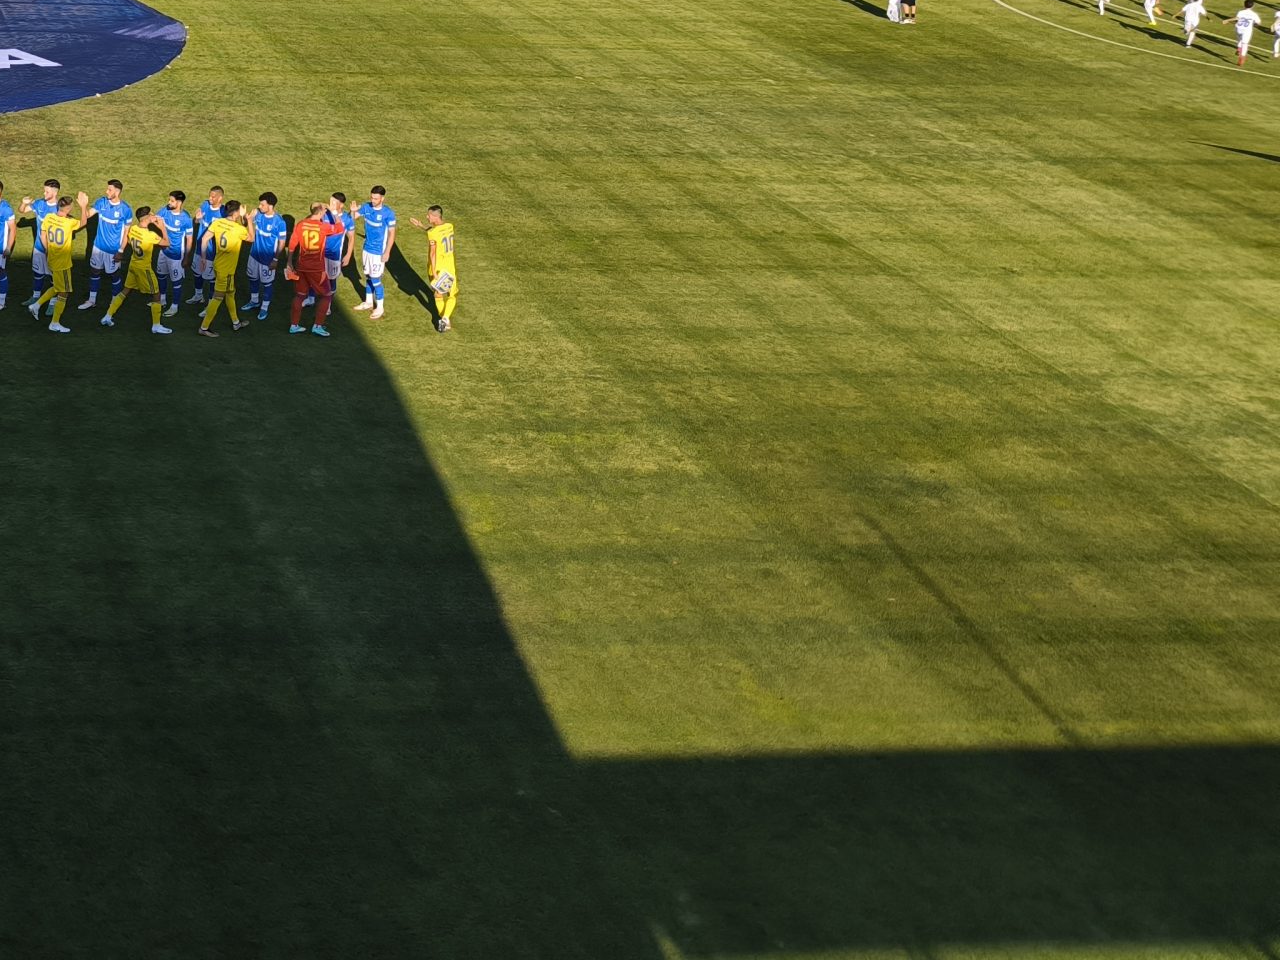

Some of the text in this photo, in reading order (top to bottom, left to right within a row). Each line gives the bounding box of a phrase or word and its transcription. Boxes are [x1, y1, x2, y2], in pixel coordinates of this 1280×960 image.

[47, 225, 65, 246] 60
[220, 231, 227, 249] 6
[302, 230, 320, 250] 12
